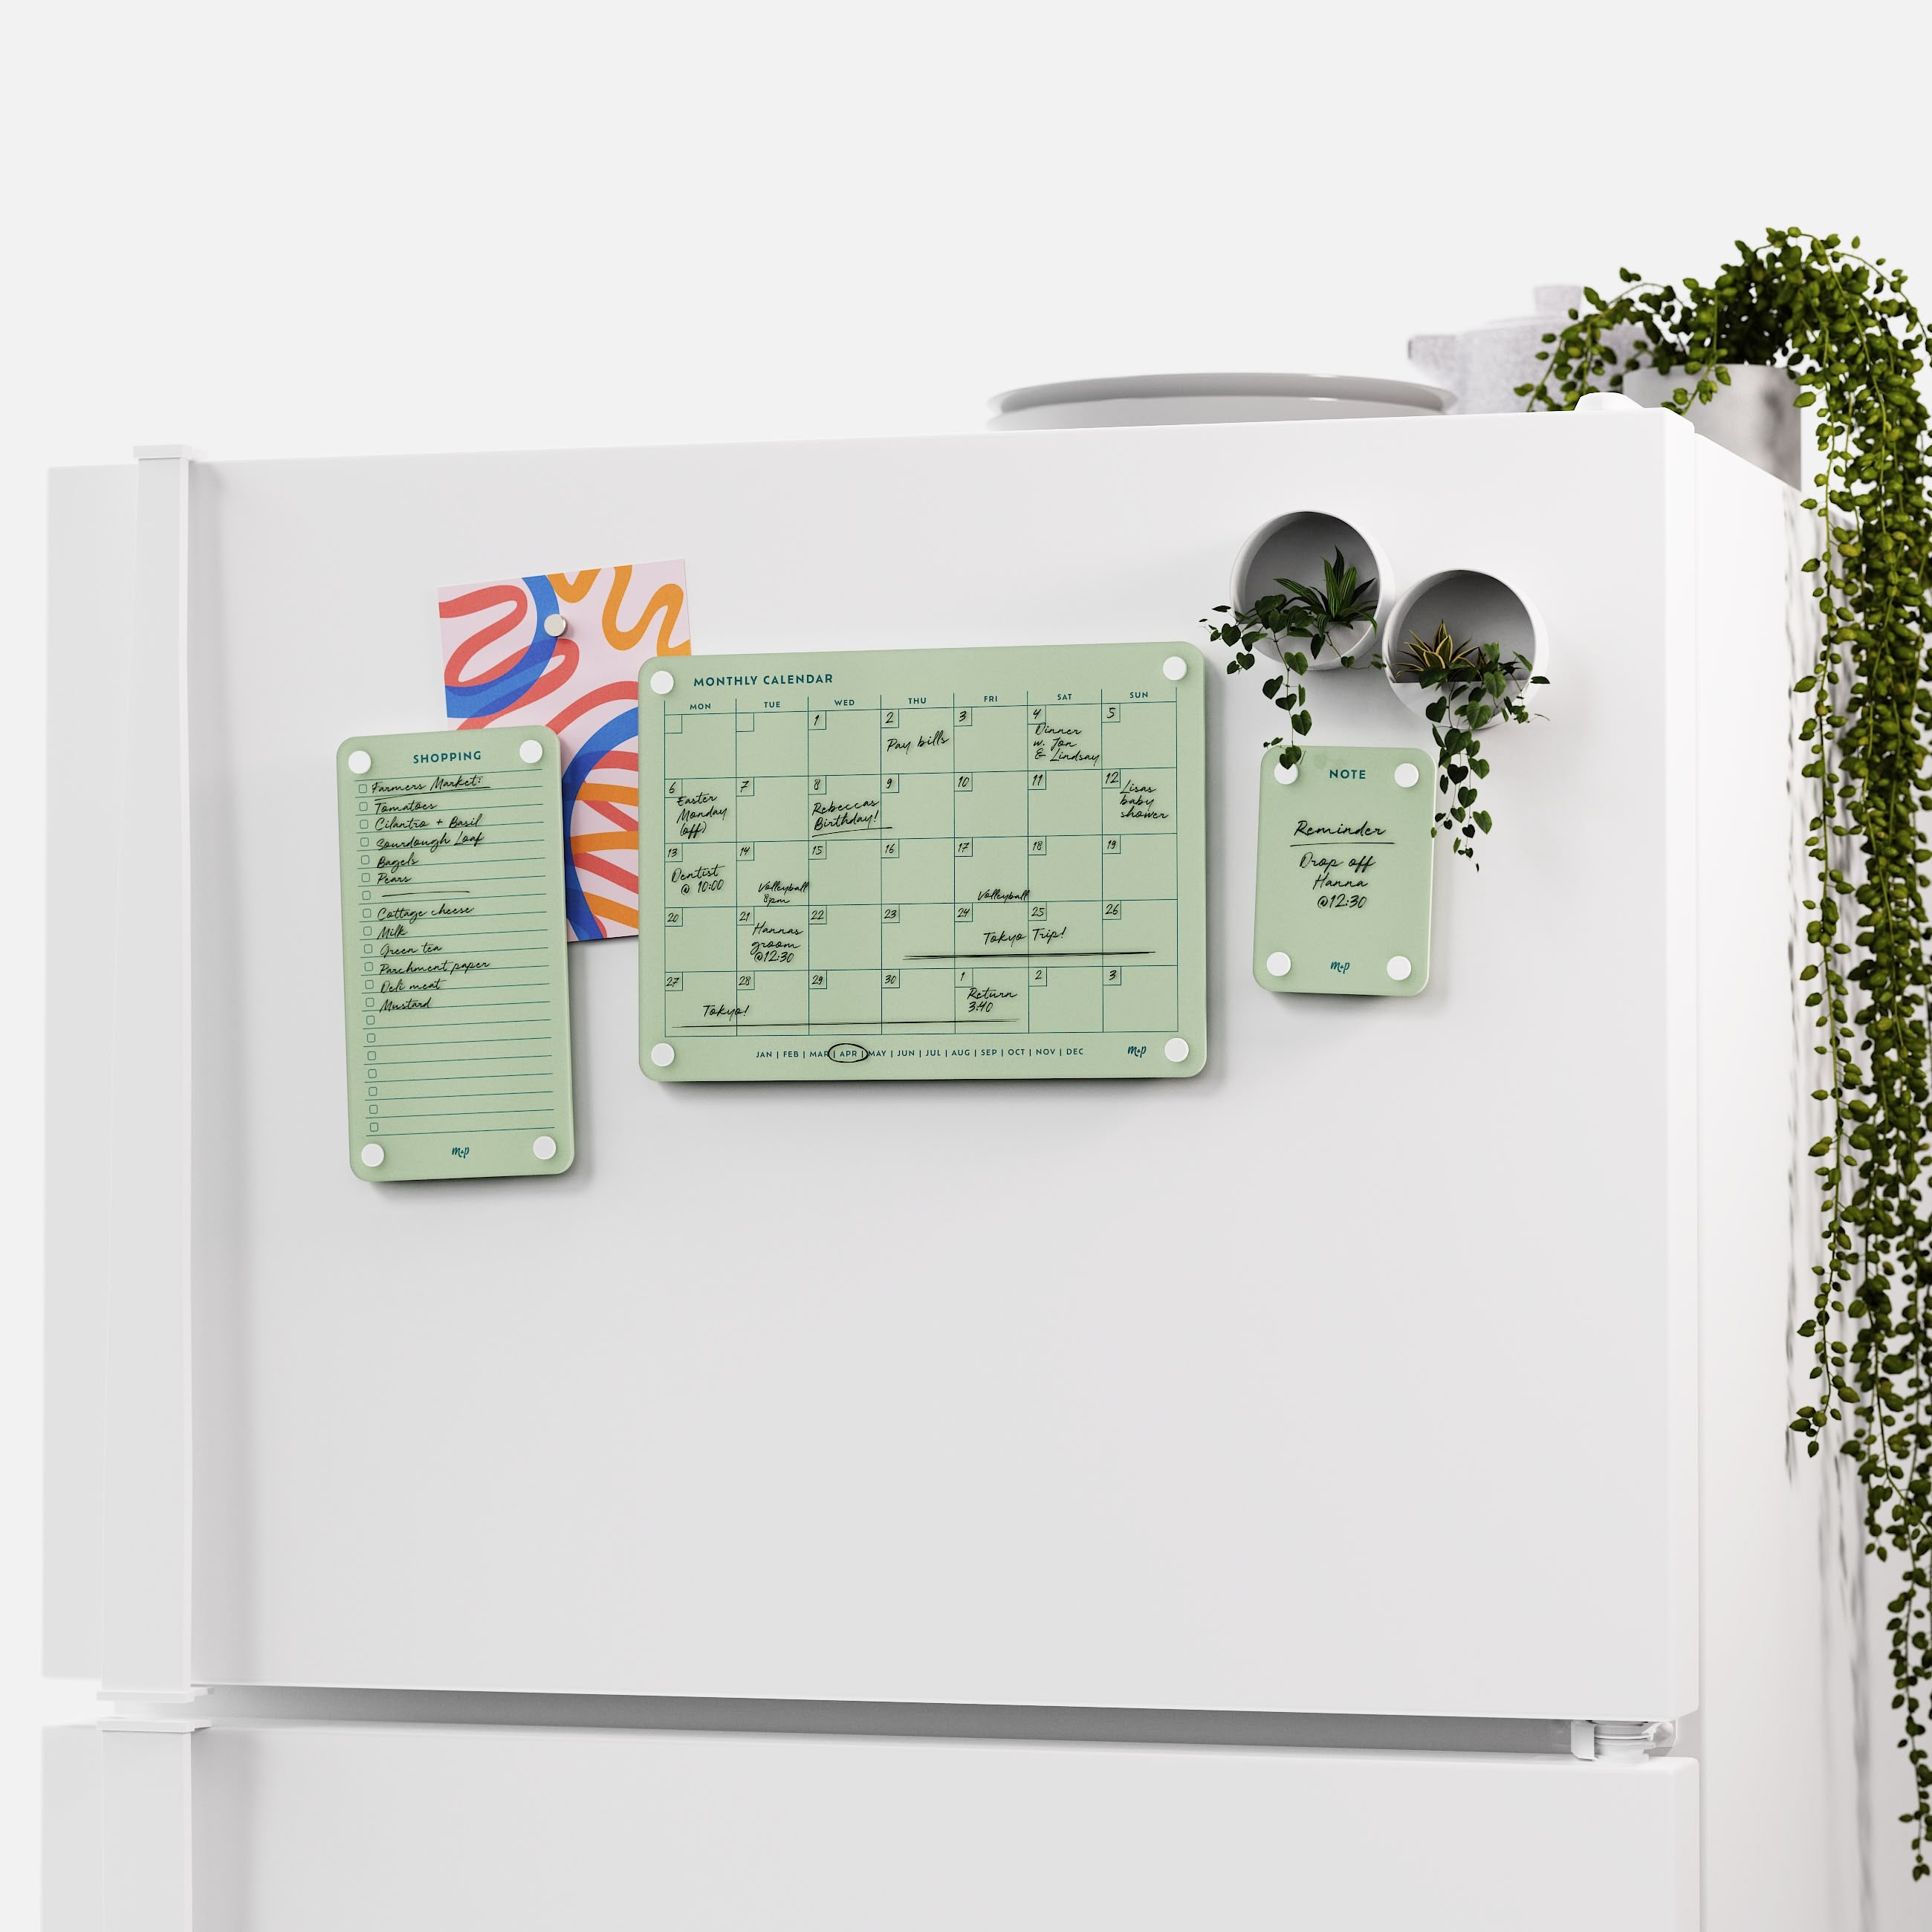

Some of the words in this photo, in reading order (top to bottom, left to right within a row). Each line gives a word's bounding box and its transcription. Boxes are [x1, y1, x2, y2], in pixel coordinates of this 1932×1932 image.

[693, 675, 758, 687] MONTHLY
[763, 674, 833, 685] CALENDAR
[886, 712, 894, 723] 2
[959, 711, 966, 722] 3
[1034, 709, 1041, 719] 4
[1107, 707, 1115, 718] 5
[814, 715, 819, 725] 1
[1035, 723, 1082, 736] Dinner
[887, 738, 911, 755] Pay
[917, 730, 950, 748] bills
[1050, 738, 1077, 751] Jon
[413, 751, 481, 763] SHOPPING
[1050, 748, 1100, 766] Lindsay
[1033, 775, 1043, 786] 11
[1106, 771, 1119, 783] 12
[1330, 770, 1366, 779] NOTE
[669, 782, 675, 794] 6
[740, 781, 748, 792] 7
[814, 779, 820, 791] 8
[886, 779, 892, 789] 9
[958, 777, 970, 787] 10
[1120, 779, 1156, 794] Lisas
[372, 783, 427, 794] Farmers
[677, 793, 718, 806] Easter
[1120, 795, 1154, 807] baby
[375, 802, 437, 814] Tomatoes
[812, 798, 879, 816] Rebeccas
[1120, 806, 1169, 819] shower
[677, 807, 727, 823] Monday
[814, 810, 878, 831] Birthday!
[375, 817, 429, 831] Cilantro
[448, 814, 482, 829] Basil
[1294, 820, 1386, 836] Reminder
[376, 834, 451, 852] Sourdough
[454, 832, 484, 847] Loaf
[959, 843, 969, 852] 17
[1033, 841, 1042, 851] 18
[1107, 840, 1116, 849] 19
[667, 849, 678, 857] 13
[740, 846, 751, 856] 14
[812, 846, 823, 855] 15
[885, 844, 894, 853] 16
[376, 852, 419, 873] Bagels
[1300, 852, 1343, 873] Drop
[1348, 855, 1375, 872] off
[377, 872, 412, 884] Pears
[672, 864, 725, 883] Dentist
[698, 879, 724, 893] 10:00
[1312, 872, 1368, 890] Hanna
[758, 881, 810, 894] Volleyball
[764, 894, 790, 907] 8pm
[978, 889, 1030, 903] Volleyball
[1317, 894, 1367, 908] @12:30
[377, 907, 427, 923] Cottage
[431, 904, 474, 916] cheese
[811, 911, 824, 920] 22
[885, 910, 897, 919] 23
[957, 908, 970, 918] 24
[1032, 907, 1044, 917] 25
[1106, 904, 1118, 915] 26
[667, 913, 679, 922] 20
[740, 912, 750, 922] 21
[377, 924, 408, 939] Milk
[752, 921, 804, 935] Hannas
[983, 931, 1027, 947] Tokyo
[1033, 927, 1066, 944] Trip!
[380, 944, 418, 958] Green
[423, 943, 442, 953] tea
[751, 939, 801, 955] groom
[753, 951, 794, 963] @12:30
[380, 960, 453, 975] Parchment
[450, 961, 490, 975] paper
[739, 976, 751, 986] 28
[812, 975, 823, 985] 29
[885, 975, 896, 984] 30
[960, 972, 965, 981] 1
[1035, 970, 1043, 980] 2
[1109, 970, 1116, 981] 3
[380, 979, 405, 993] Deli
[409, 978, 447, 991] meat
[666, 977, 679, 987] 27
[967, 988, 1017, 999] Return
[379, 997, 432, 1013] Mustard
[968, 1001, 993, 1013] 3:40
[703, 1005, 750, 1021] Tokyo!
